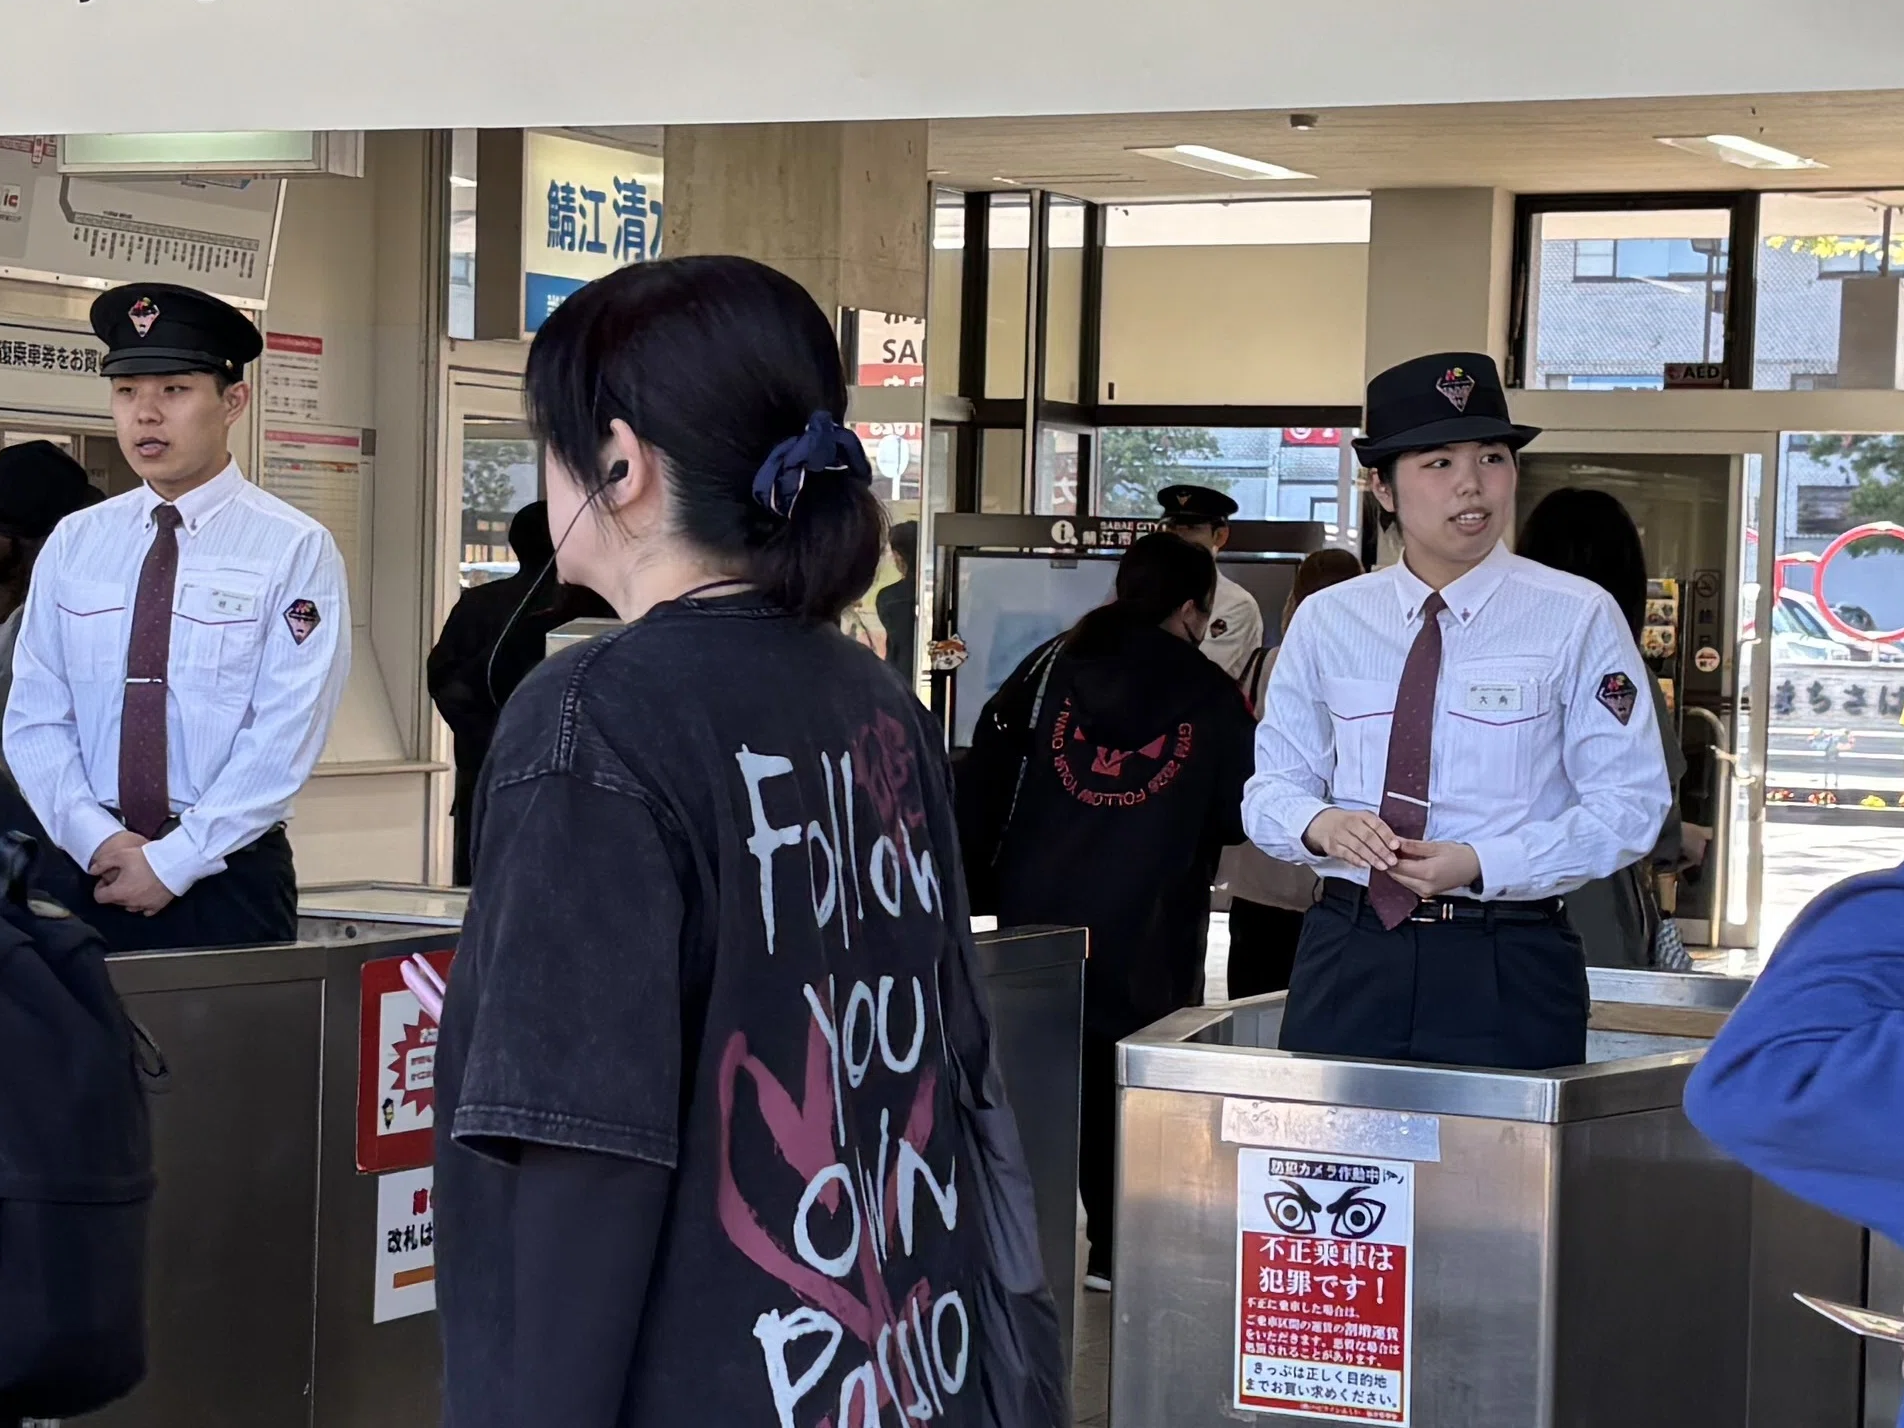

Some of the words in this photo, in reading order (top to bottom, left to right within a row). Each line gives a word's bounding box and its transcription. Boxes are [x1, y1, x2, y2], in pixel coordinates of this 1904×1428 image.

[882, 338, 925, 364] SA
[1683, 365, 1720, 379] AED
[1052, 711, 1071, 750] OWN
[1259, 1236, 1394, 1271] 不正乗車は
[1254, 1362, 1387, 1388] きっぷは正しく目的地
[1245, 1377, 1398, 1408] までお買い求めください。
